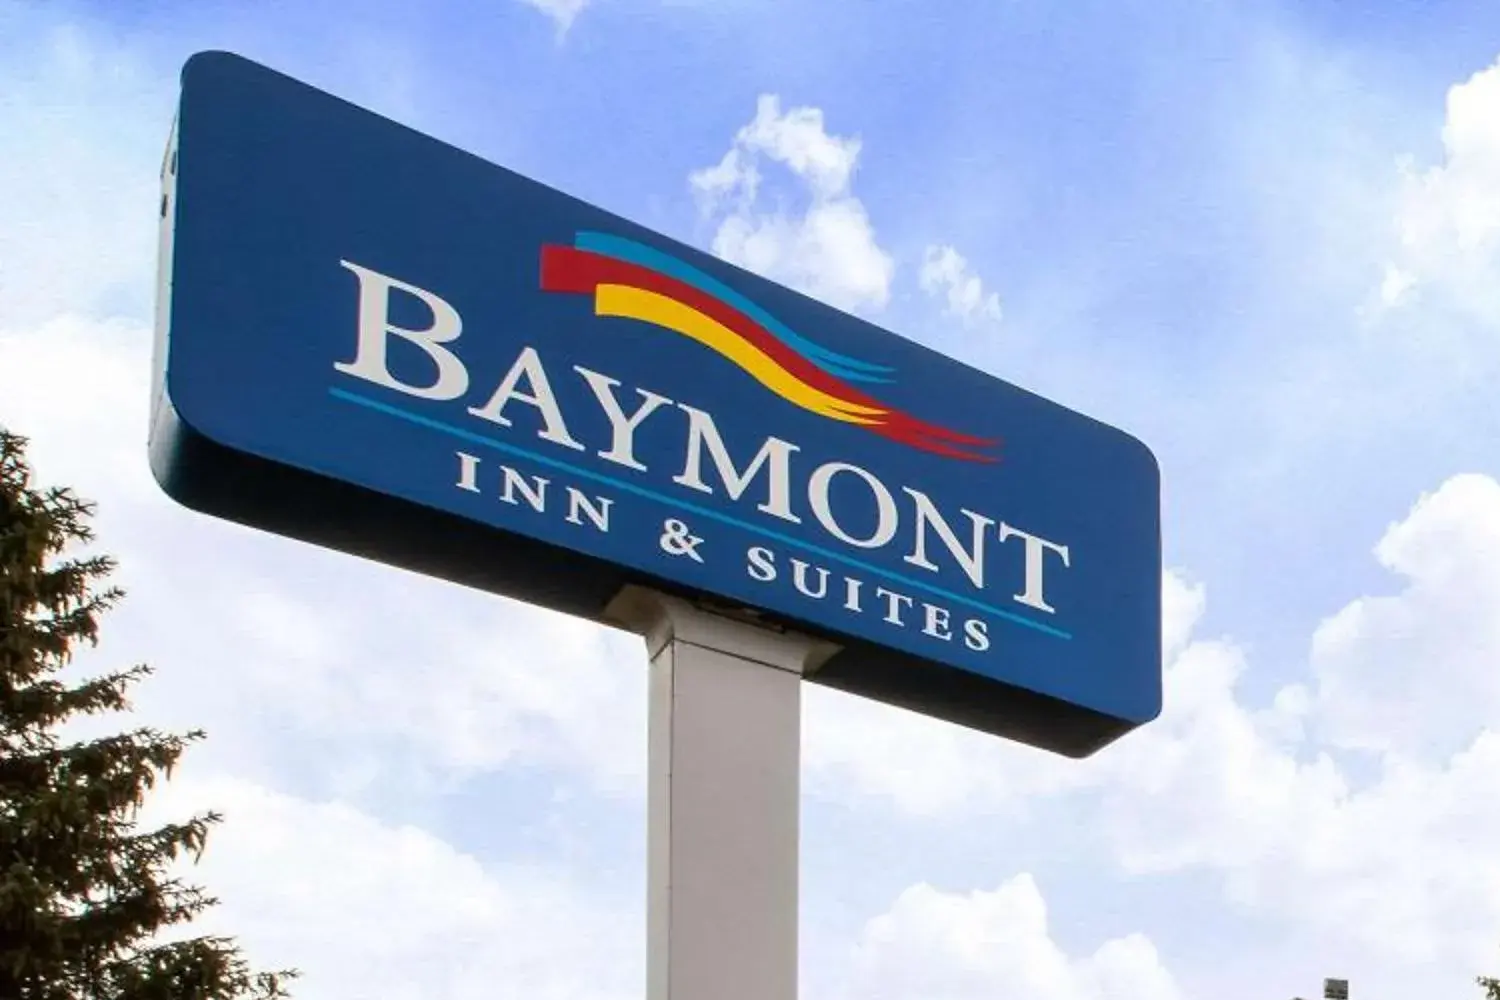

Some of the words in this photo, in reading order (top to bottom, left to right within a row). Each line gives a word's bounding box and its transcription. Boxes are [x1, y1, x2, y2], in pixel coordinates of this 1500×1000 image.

[334, 259, 1070, 613] BAYMONT
[456, 451, 612, 532] INN
[660, 519, 704, 562] &
[747, 547, 990, 651] SUITES
